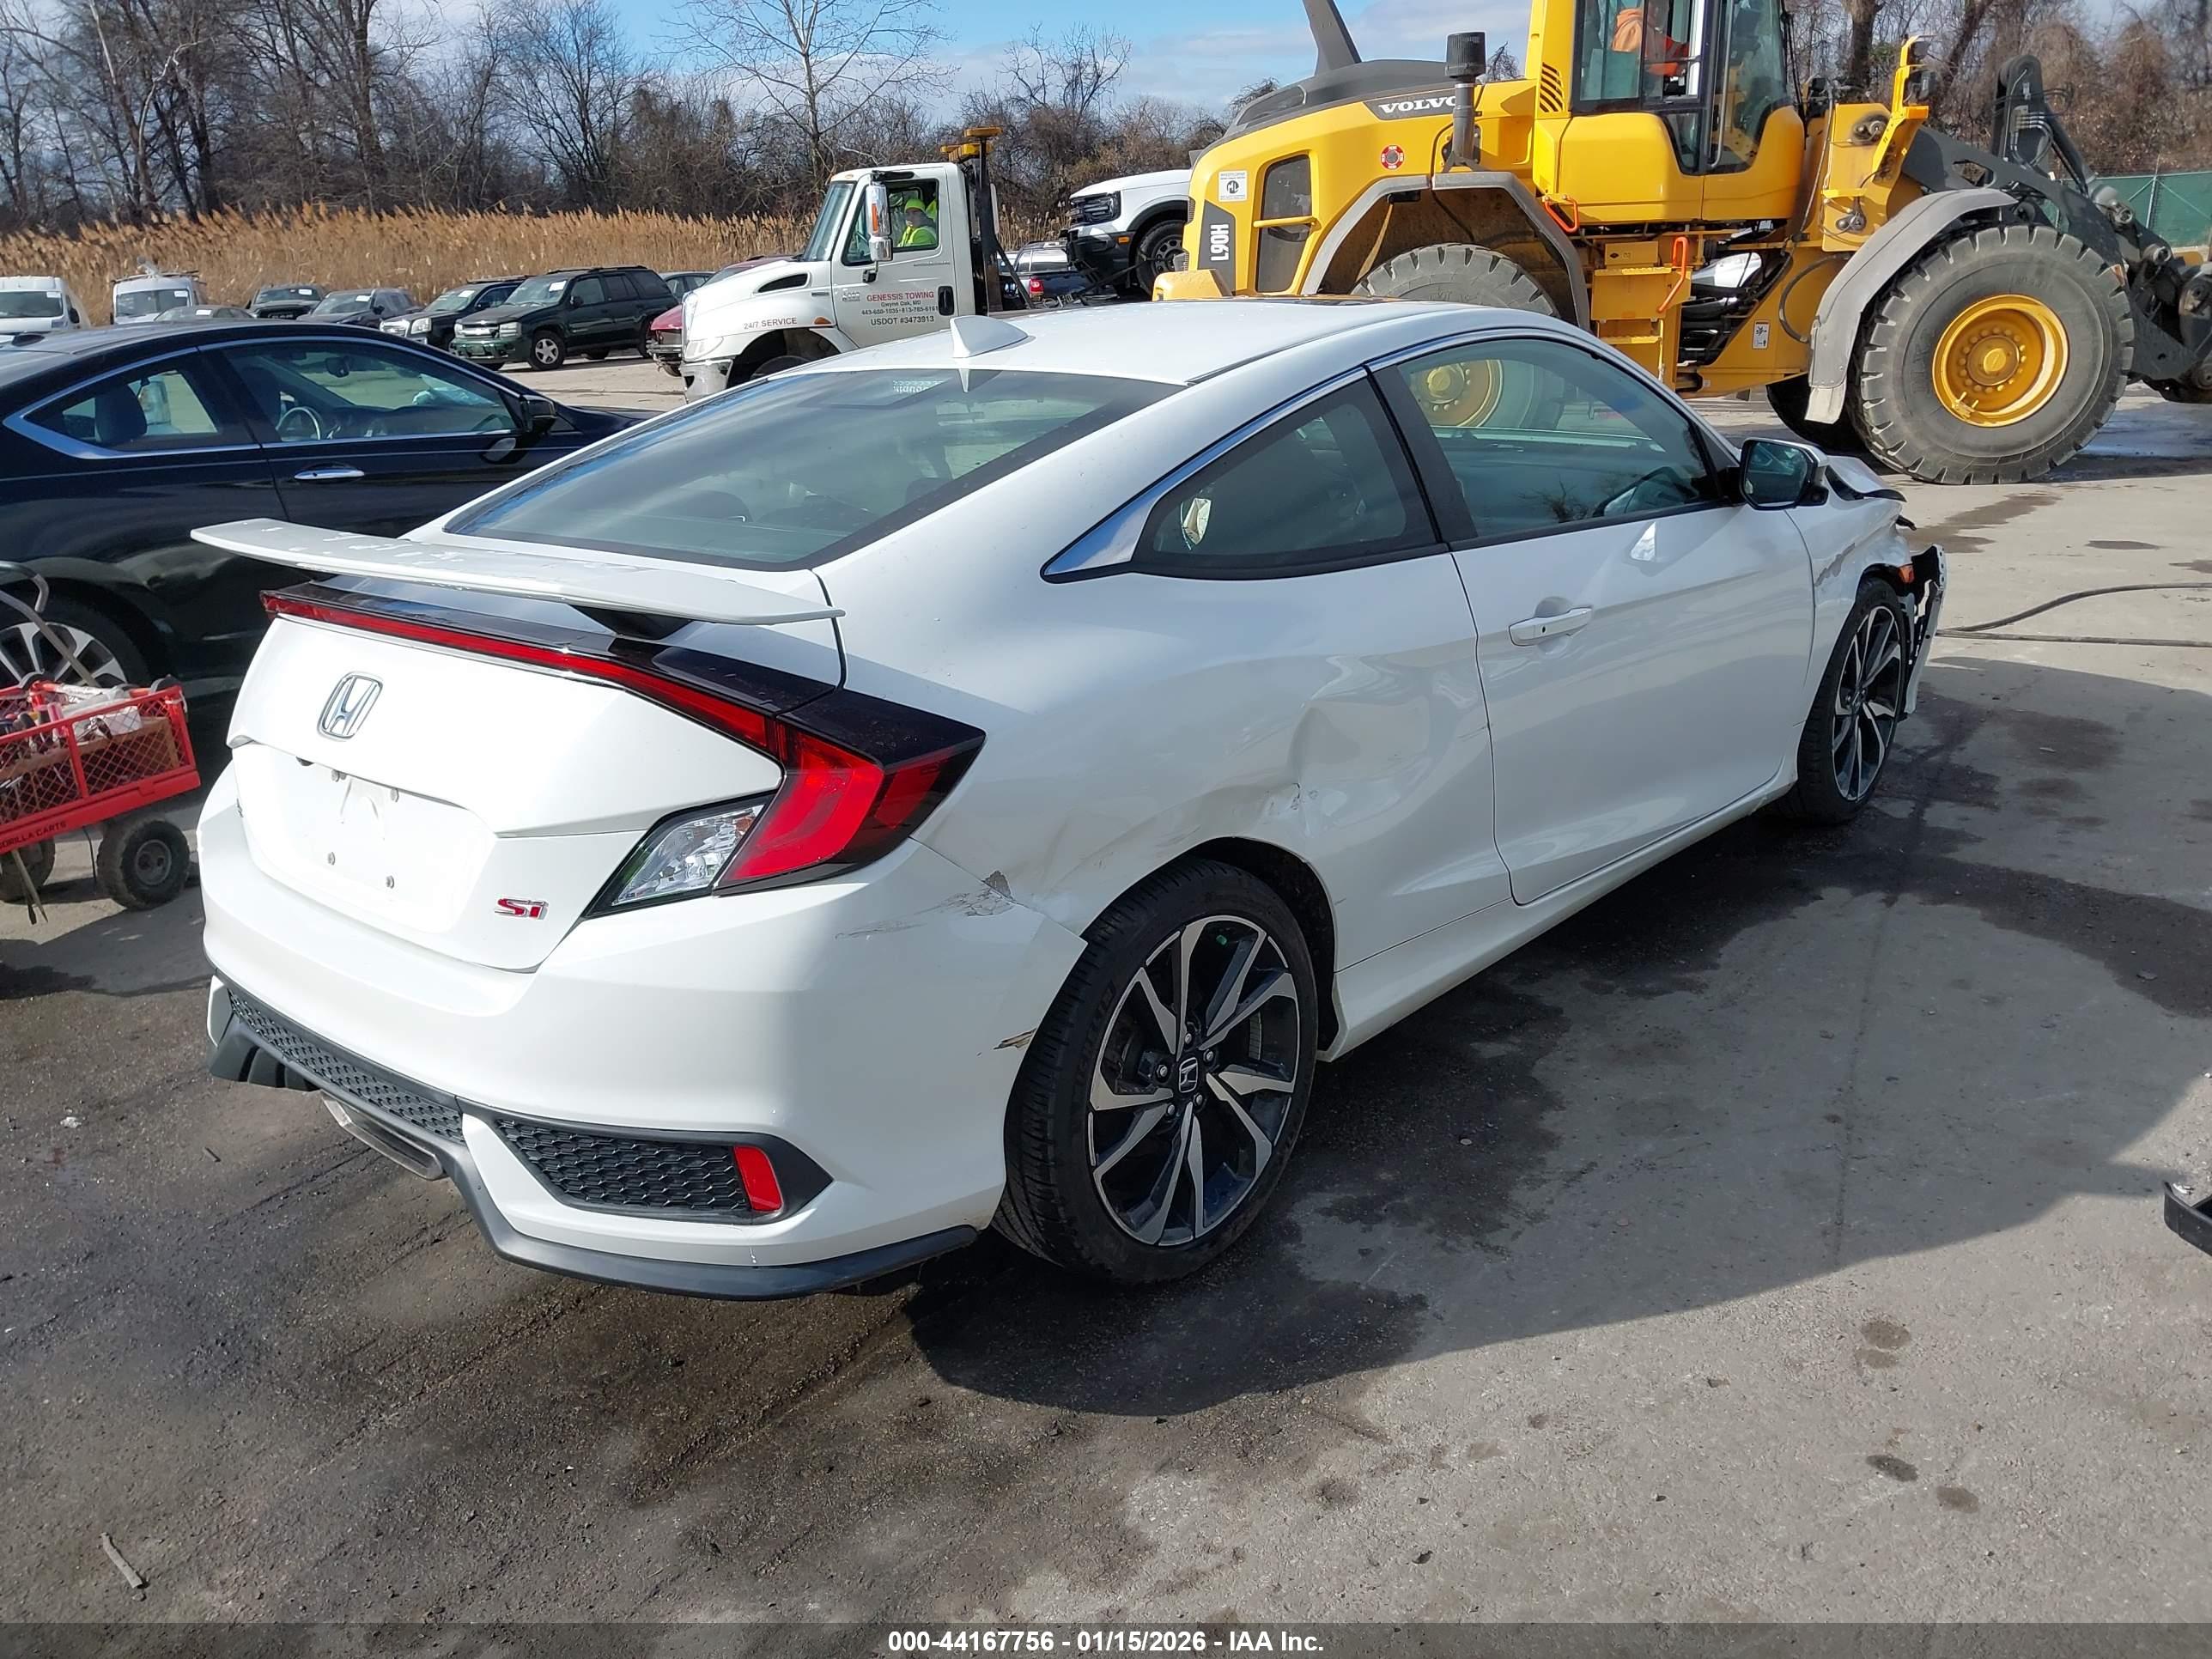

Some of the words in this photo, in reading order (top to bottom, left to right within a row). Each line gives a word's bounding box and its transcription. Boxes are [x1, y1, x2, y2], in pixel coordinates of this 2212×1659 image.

[1210, 224, 1230, 261] L90H
[866, 293, 903, 302] GENESSIS
[905, 291, 934, 301] TOWING
[744, 321, 759, 330] 24/7
[761, 317, 798, 327] SERVICE
[871, 317, 897, 325] USDOT
[900, 315, 934, 324] #3473913
[36, 822, 67, 836] CARTS
